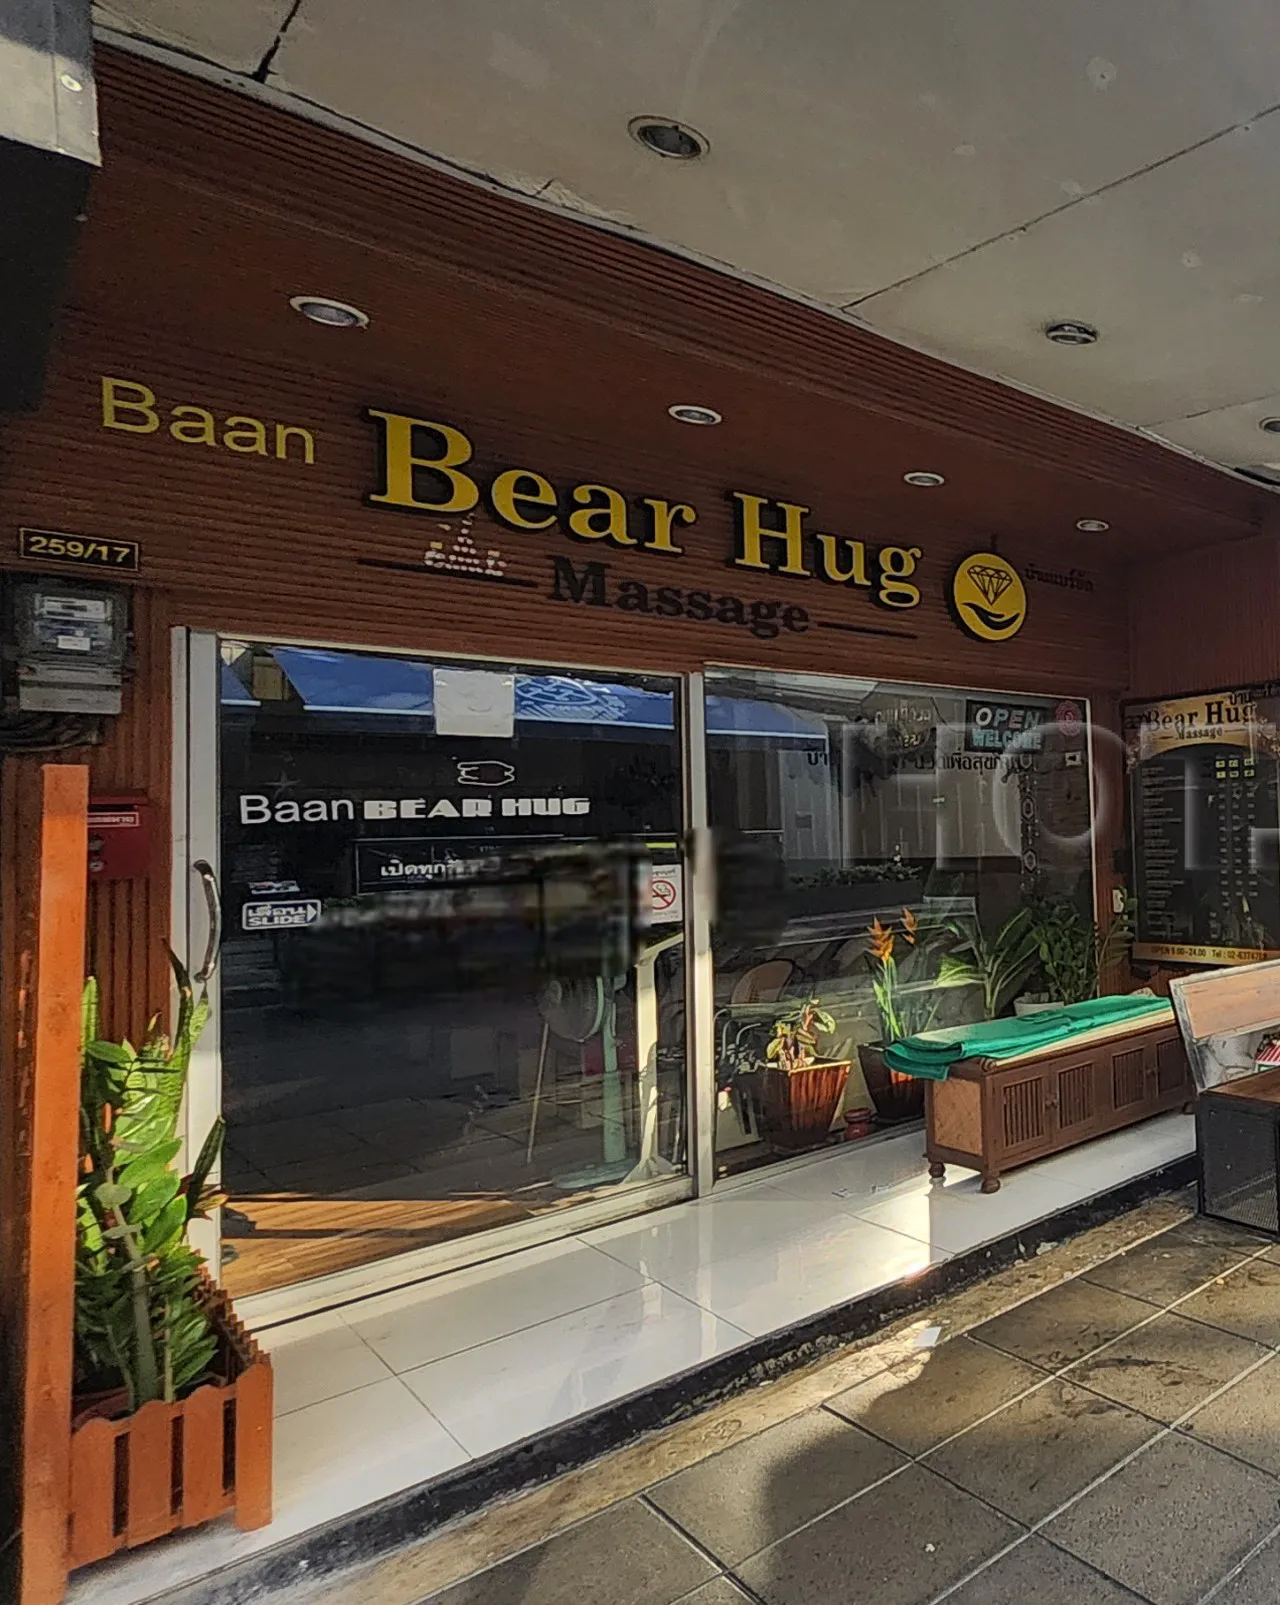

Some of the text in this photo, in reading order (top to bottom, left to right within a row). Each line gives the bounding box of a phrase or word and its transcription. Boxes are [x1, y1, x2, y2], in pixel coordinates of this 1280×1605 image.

[101, 376, 315, 465] Baan
[367, 408, 924, 609] Bear Hug
[28, 535, 131, 564] 259/17
[546, 555, 811, 639] Massage
[976, 707, 1040, 729] OPEN
[1146, 707, 1199, 731] Bear
[1204, 700, 1255, 726] Hug
[972, 728, 1042, 750] WELCOME
[1174, 726, 1223, 740] Massage
[239, 795, 591, 825] Baan BEAR HUG
[248, 915, 306, 926] SLIDE
